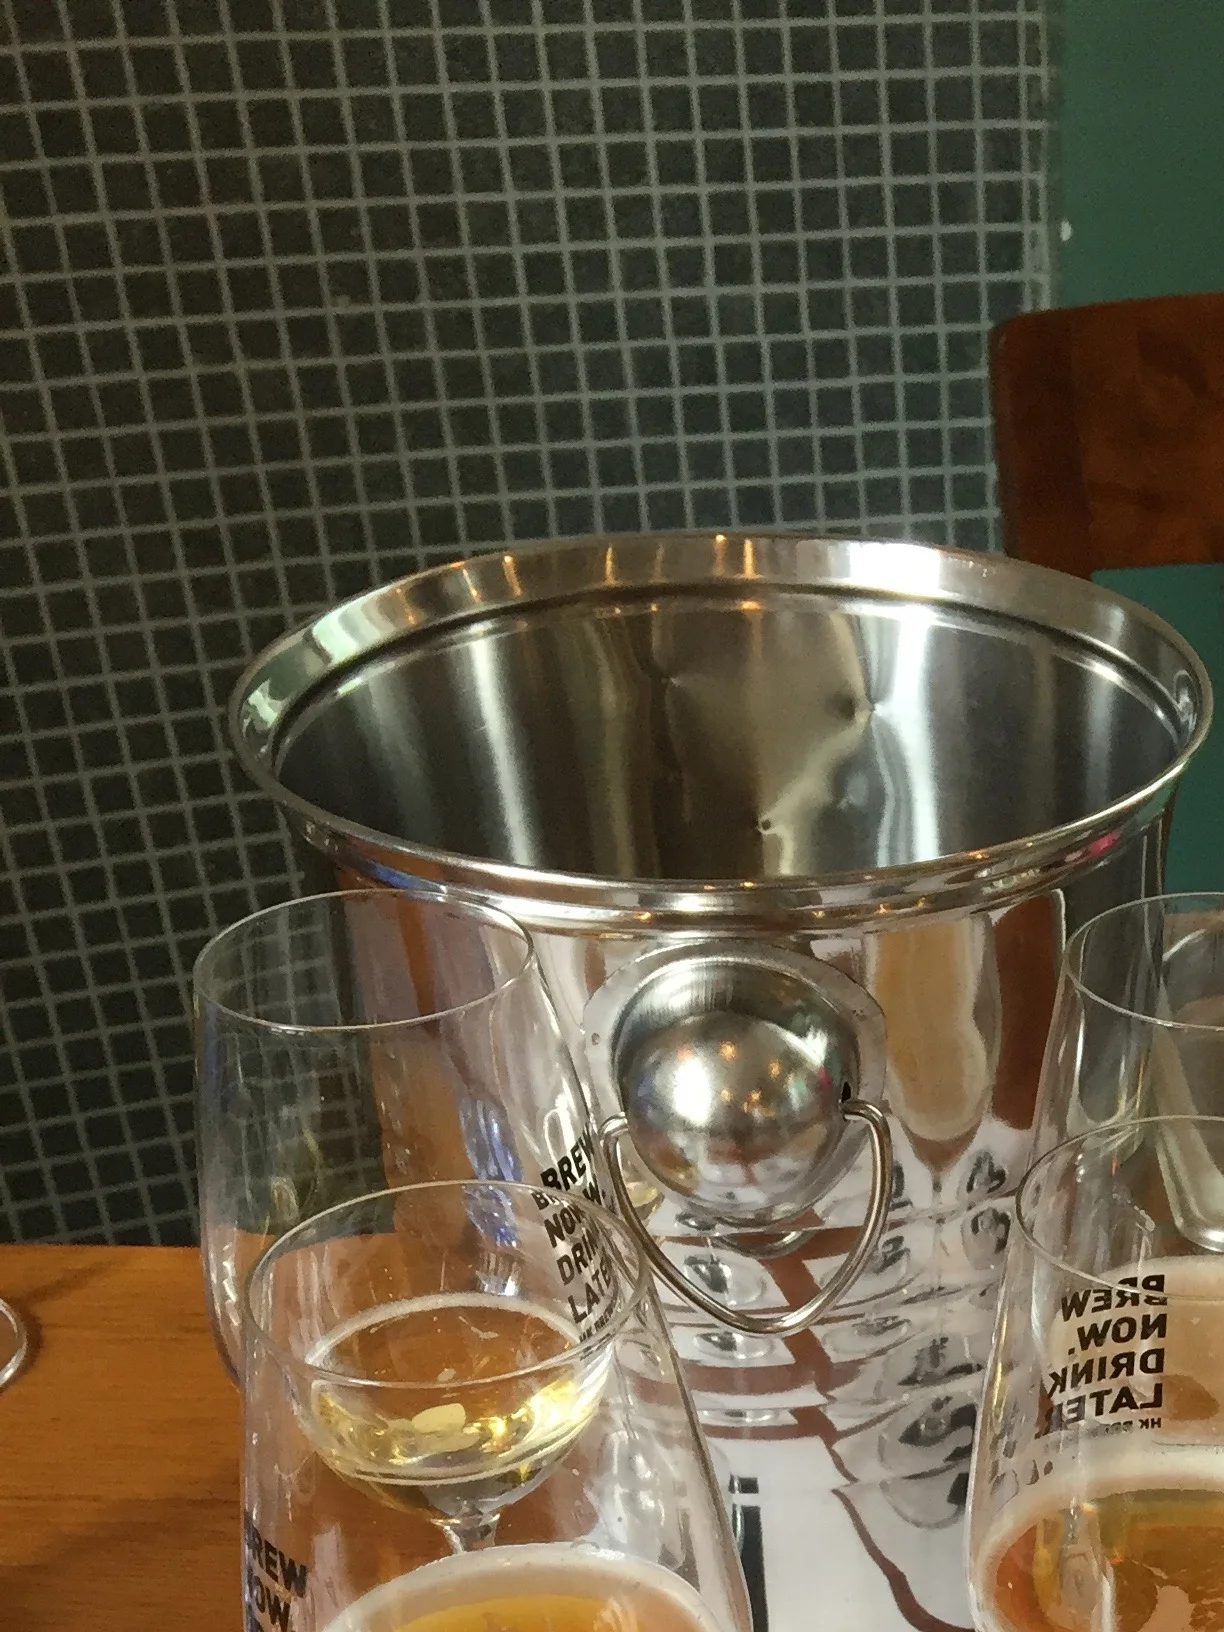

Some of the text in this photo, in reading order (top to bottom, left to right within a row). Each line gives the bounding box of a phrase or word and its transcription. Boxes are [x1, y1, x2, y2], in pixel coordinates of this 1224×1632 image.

[540, 1122, 594, 1191] BREW
[557, 1214, 601, 1286] DRIN
[568, 1246, 613, 1324] LATE
